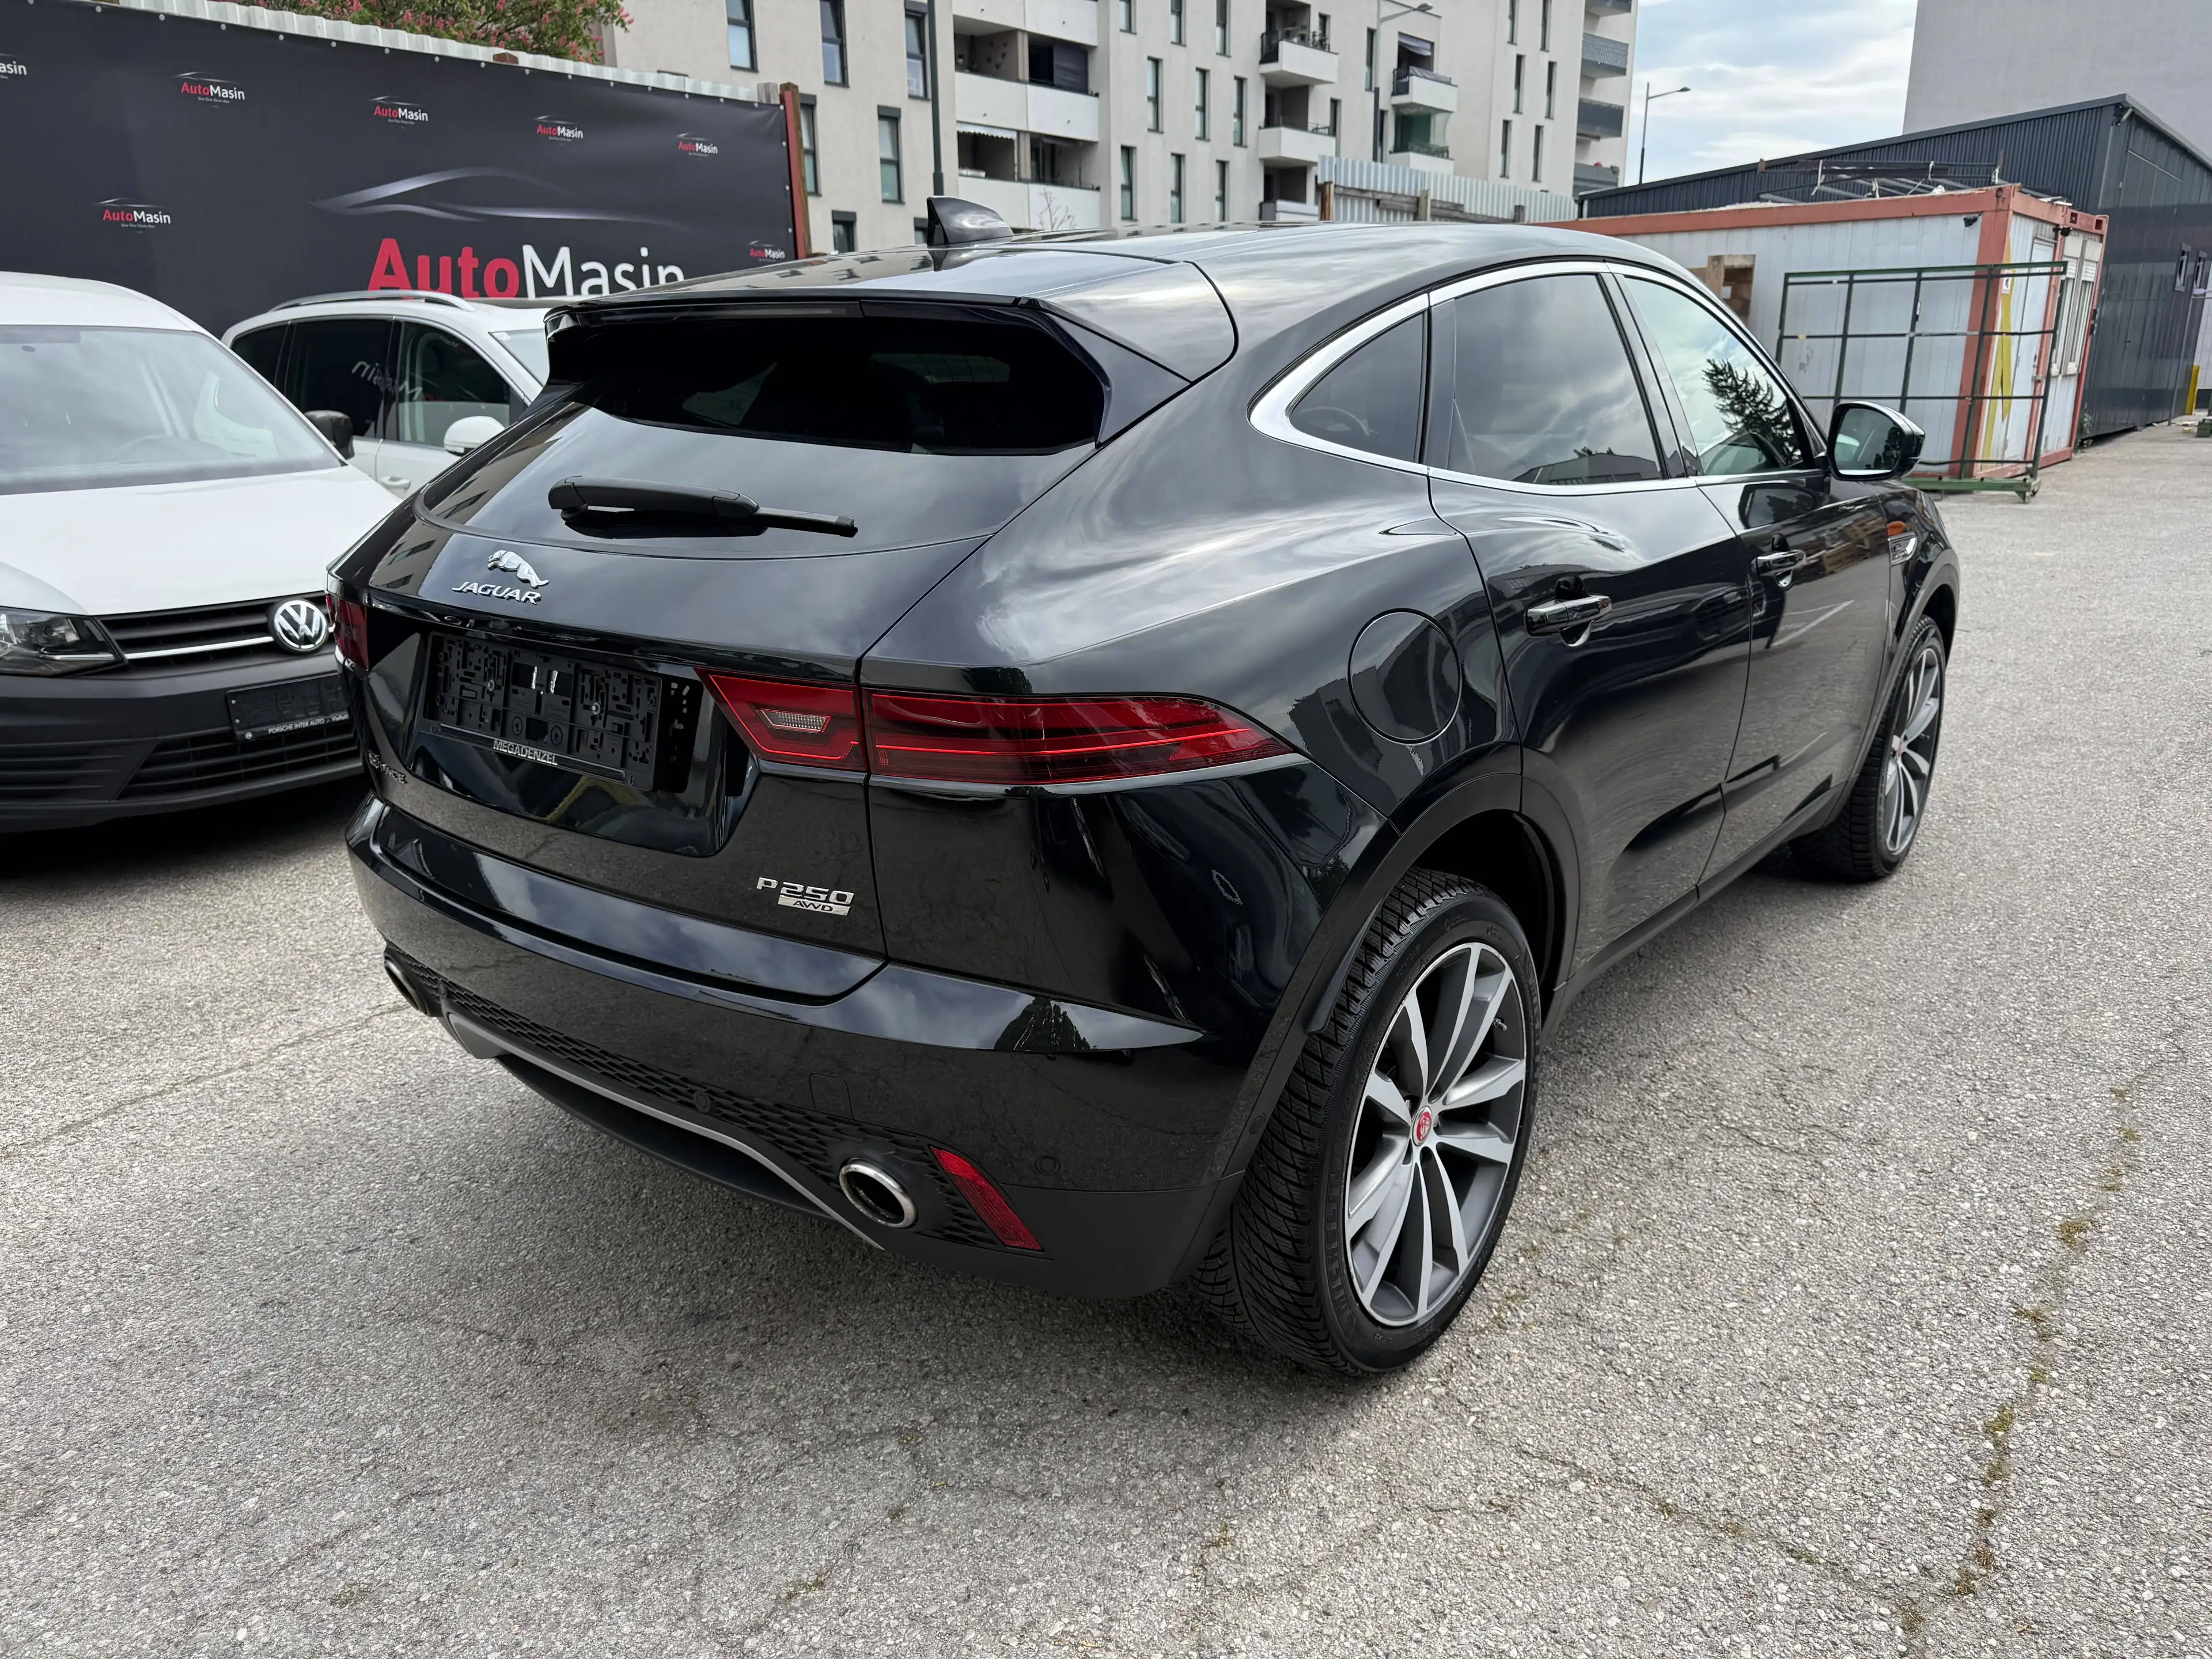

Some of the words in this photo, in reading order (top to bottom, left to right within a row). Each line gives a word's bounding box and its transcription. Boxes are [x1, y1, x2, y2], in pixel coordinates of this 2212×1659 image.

[181, 82, 245, 100] AutoMasin
[374, 105, 429, 122] AutoMasin
[537, 124, 584, 139] AutoMasin
[678, 141, 718, 154] AutoMasin
[103, 209, 171, 224] AutoMasin
[368, 238, 685, 300] AutoMasin
[452, 581, 542, 605] JAGUAR
[493, 740, 558, 766] MEGADENZEL
[793, 900, 834, 912] AWD
